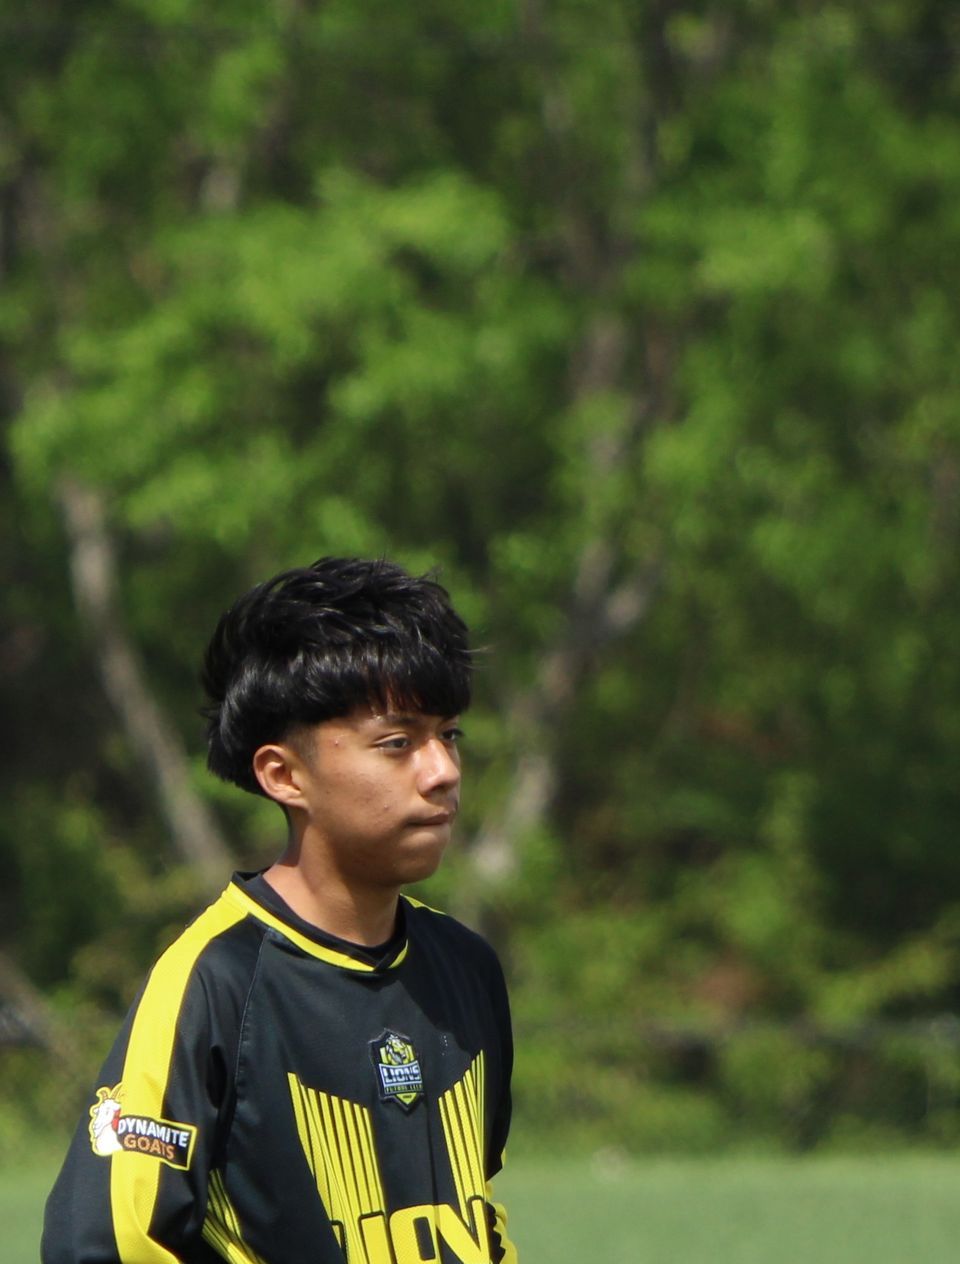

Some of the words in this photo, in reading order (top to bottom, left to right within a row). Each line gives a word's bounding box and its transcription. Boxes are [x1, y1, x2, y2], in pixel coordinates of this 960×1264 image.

[382, 1065, 421, 1083] LIONS
[117, 1117, 190, 1148] DYNAMITE
[123, 1133, 175, 1160] GOATS
